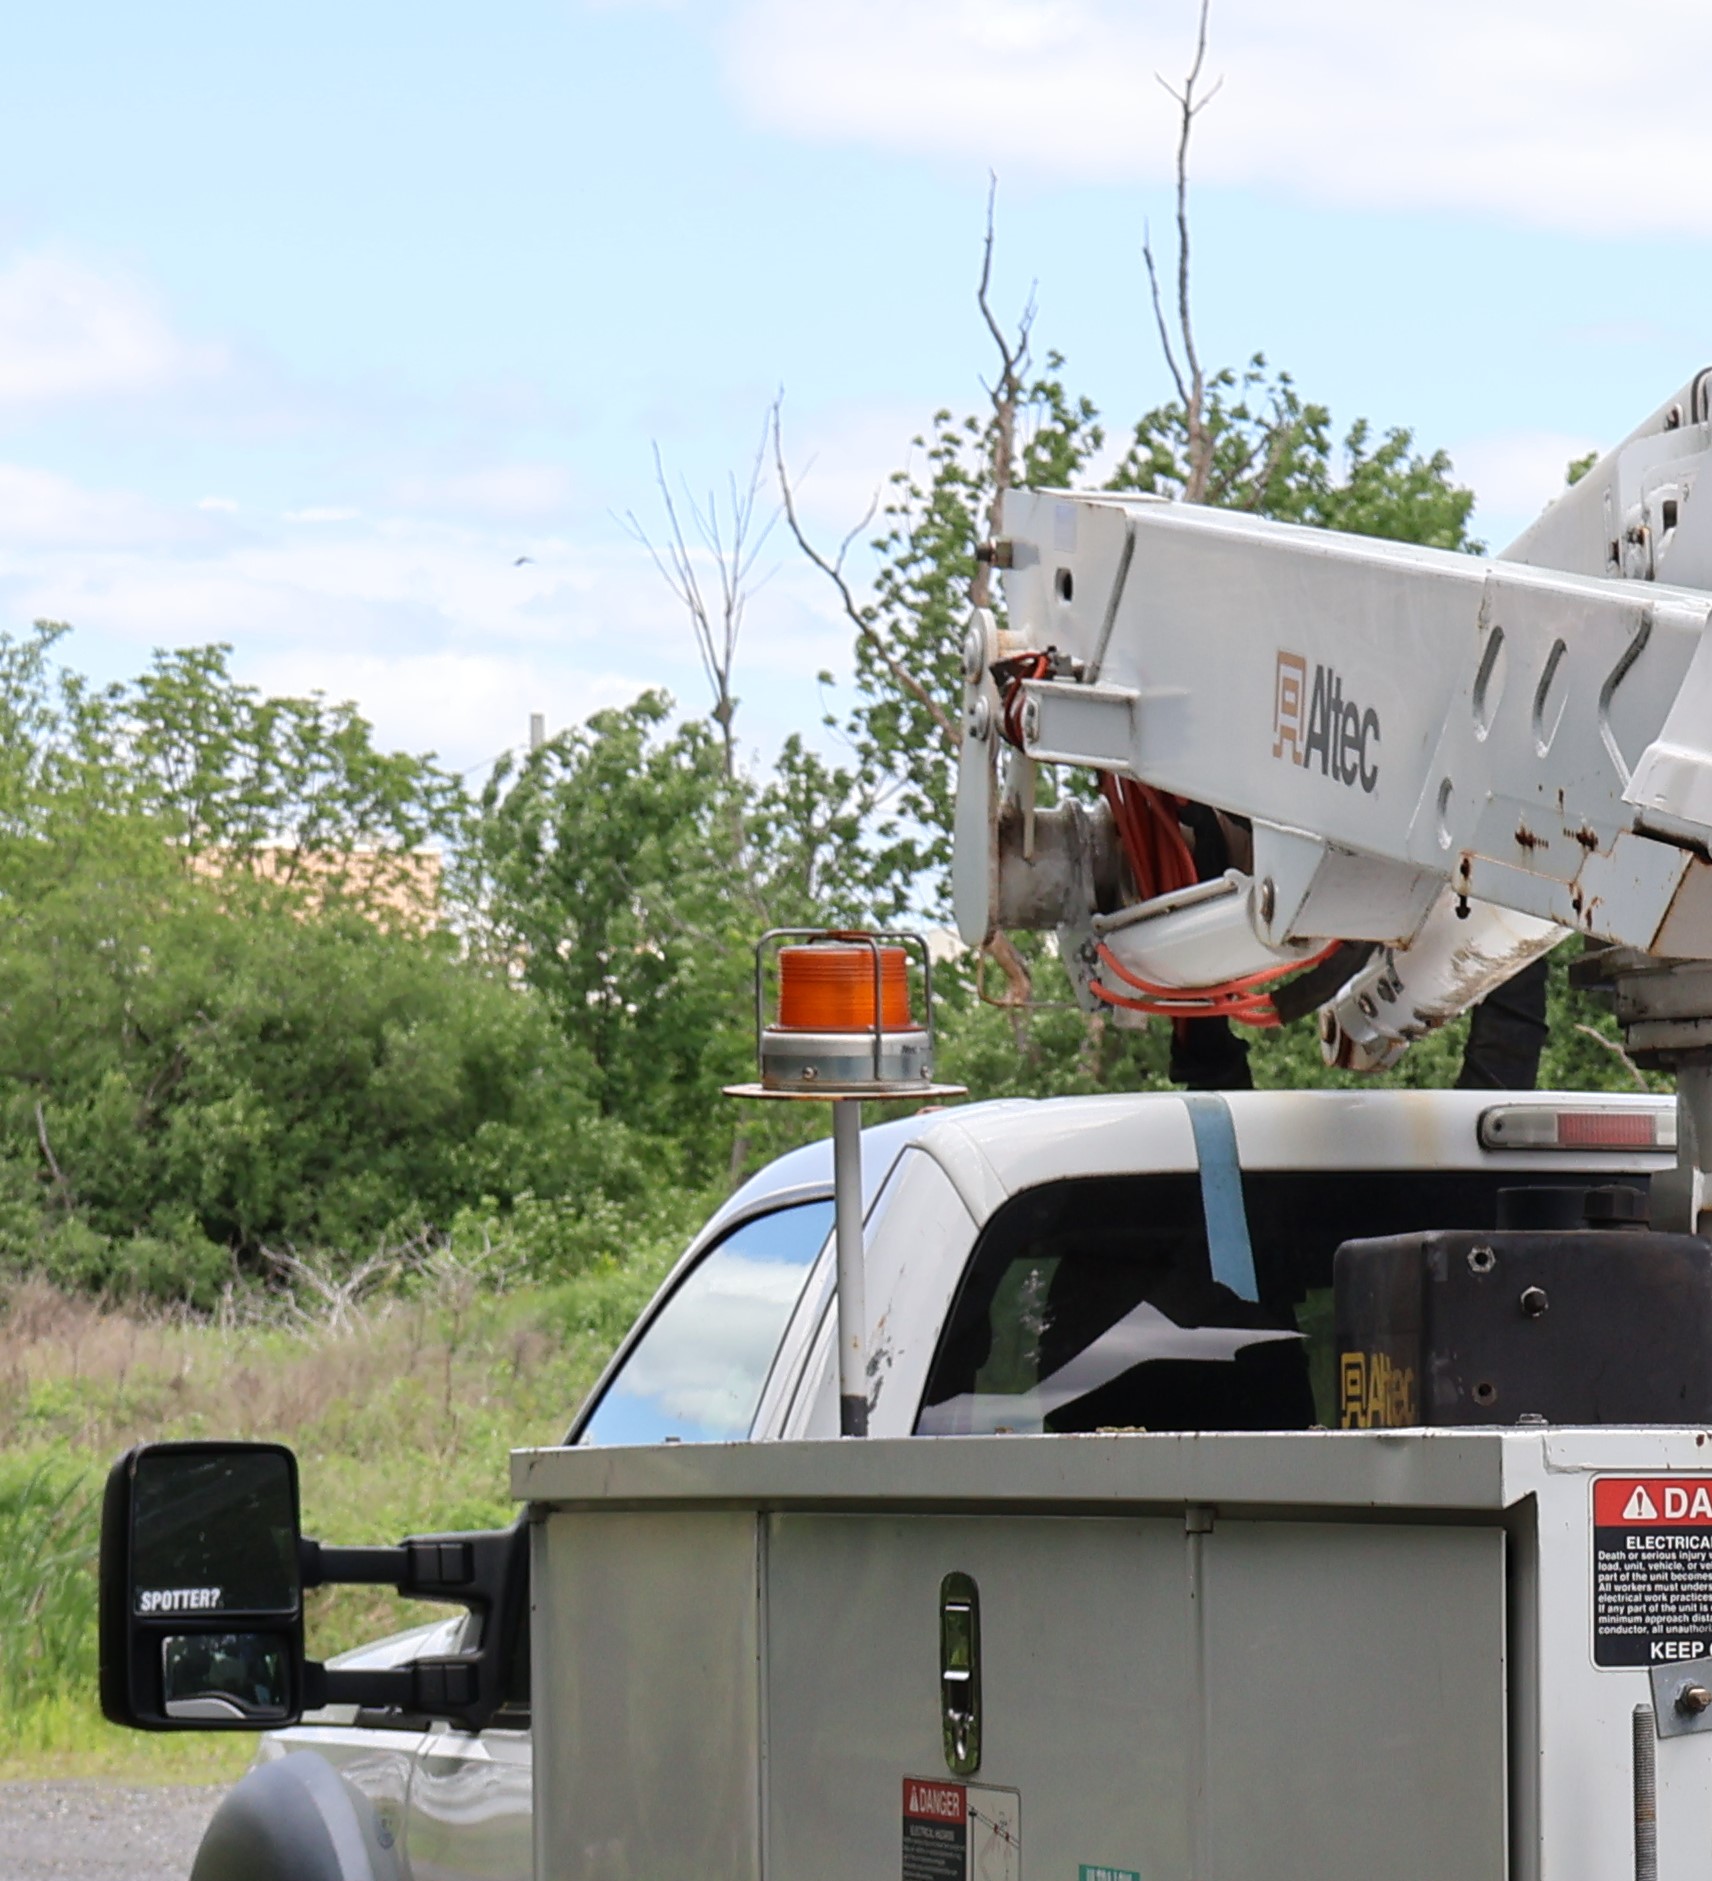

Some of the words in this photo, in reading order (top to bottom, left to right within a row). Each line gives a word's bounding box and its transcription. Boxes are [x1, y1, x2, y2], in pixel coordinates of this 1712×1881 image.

[1304, 664, 1380, 793] Altec
[1368, 1352, 1414, 1428] Altec
[1598, 1551, 1626, 1560] Death
[1641, 1551, 1677, 1560] serious
[1679, 1551, 1706, 1561] injury
[1687, 1562, 1697, 1570] or
[1598, 1572, 1618, 1582] part
[1620, 1572, 1630, 1581] of
[1632, 1572, 1647, 1581] the
[1650, 1572, 1668, 1581] unit
[1598, 1582, 1611, 1591] All
[1614, 1582, 1652, 1591] workers
[1654, 1582, 1678, 1591] must
[141, 1588, 220, 1611] SPOTTER?
[1598, 1593, 1642, 1602] electrical
[1644, 1593, 1668, 1602] work
[1598, 1604, 1605, 1613] If
[1607, 1605, 1624, 1614] any
[1627, 1604, 1646, 1614] part
[1649, 1604, 1659, 1613] of
[1661, 1603, 1676, 1612] the
[1679, 1603, 1697, 1612] unit
[1700, 1603, 1708, 1612] is
[1598, 1615, 1643, 1623] minimum
[1645, 1614, 1689, 1625] approach
[1652, 1624, 1663, 1633] all
[1650, 1641, 1704, 1659] KEEP
[919, 1788, 960, 1817] DANGER
